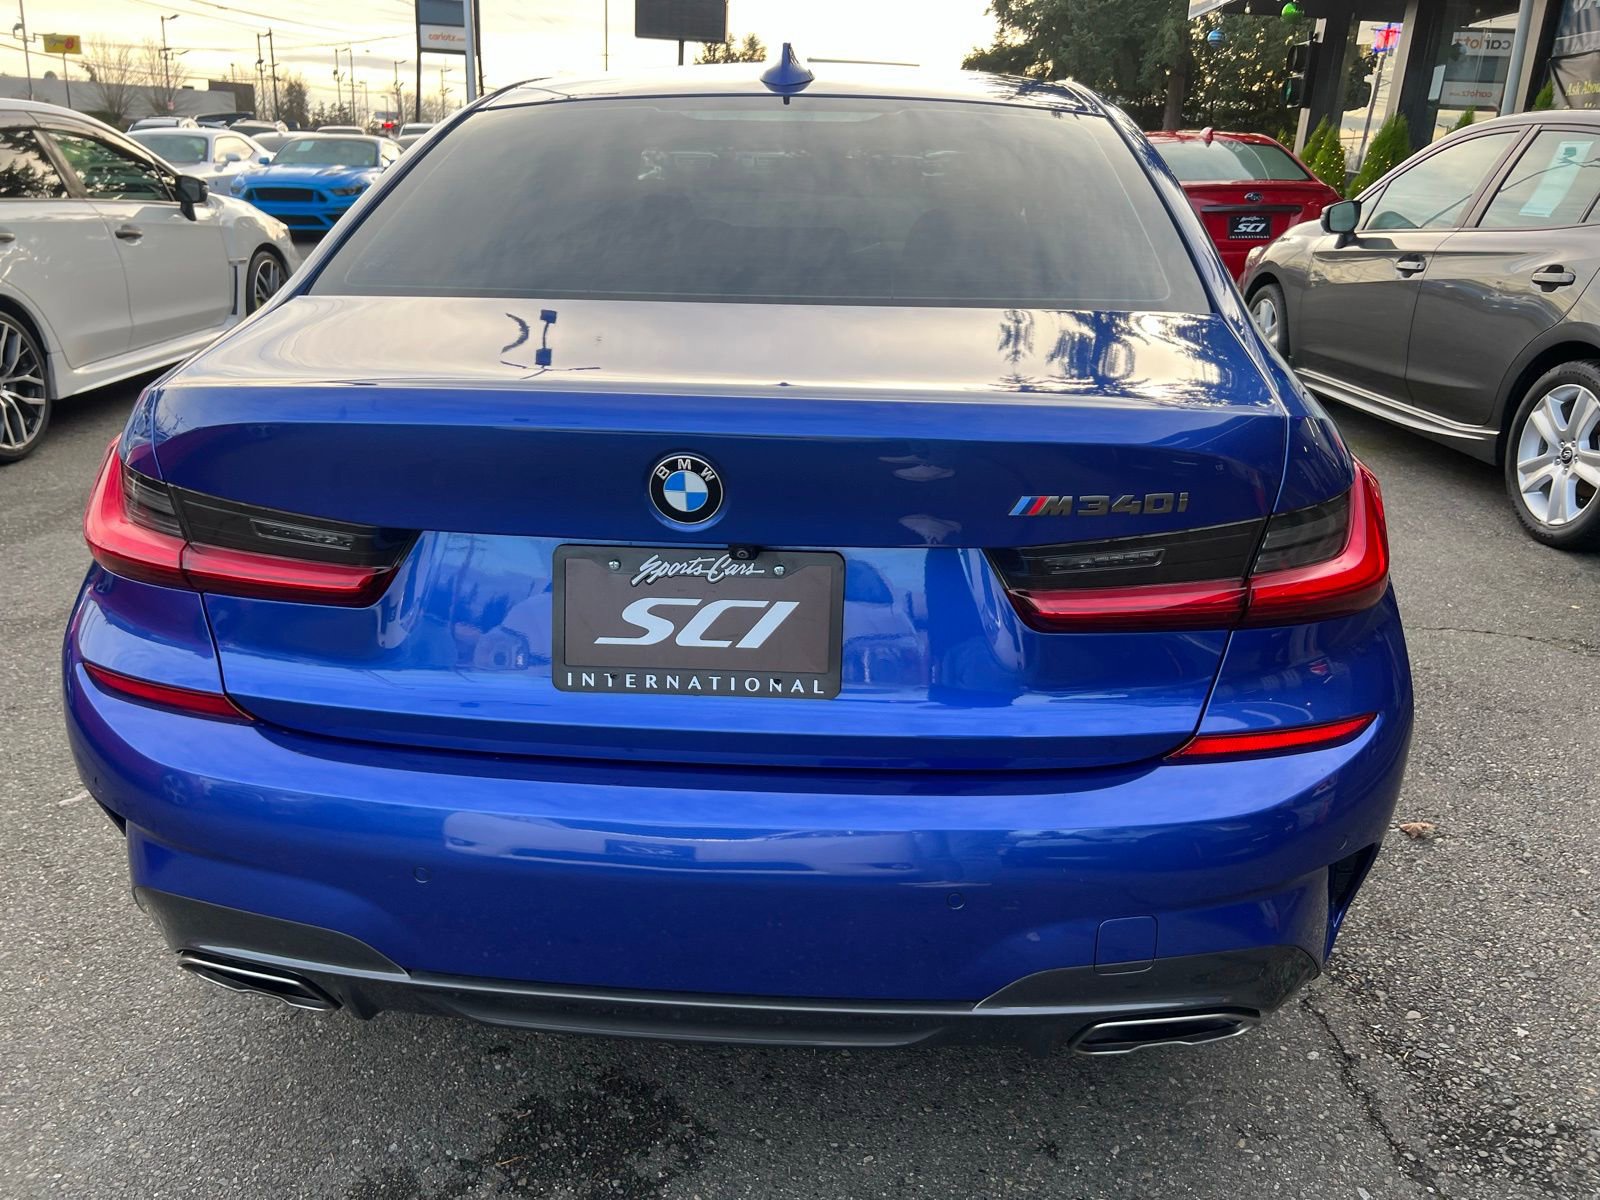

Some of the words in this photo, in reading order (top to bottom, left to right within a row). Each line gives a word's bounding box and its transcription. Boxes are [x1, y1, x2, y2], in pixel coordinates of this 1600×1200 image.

[1234, 223, 1266, 233] SCI
[655, 458, 716, 482] BMW
[1038, 492, 1189, 516] M340i
[631, 554, 714, 586] Sports
[707, 554, 765, 582] Cars
[594, 597, 800, 649] SCI
[567, 672, 825, 694] INTERNATIONAL
